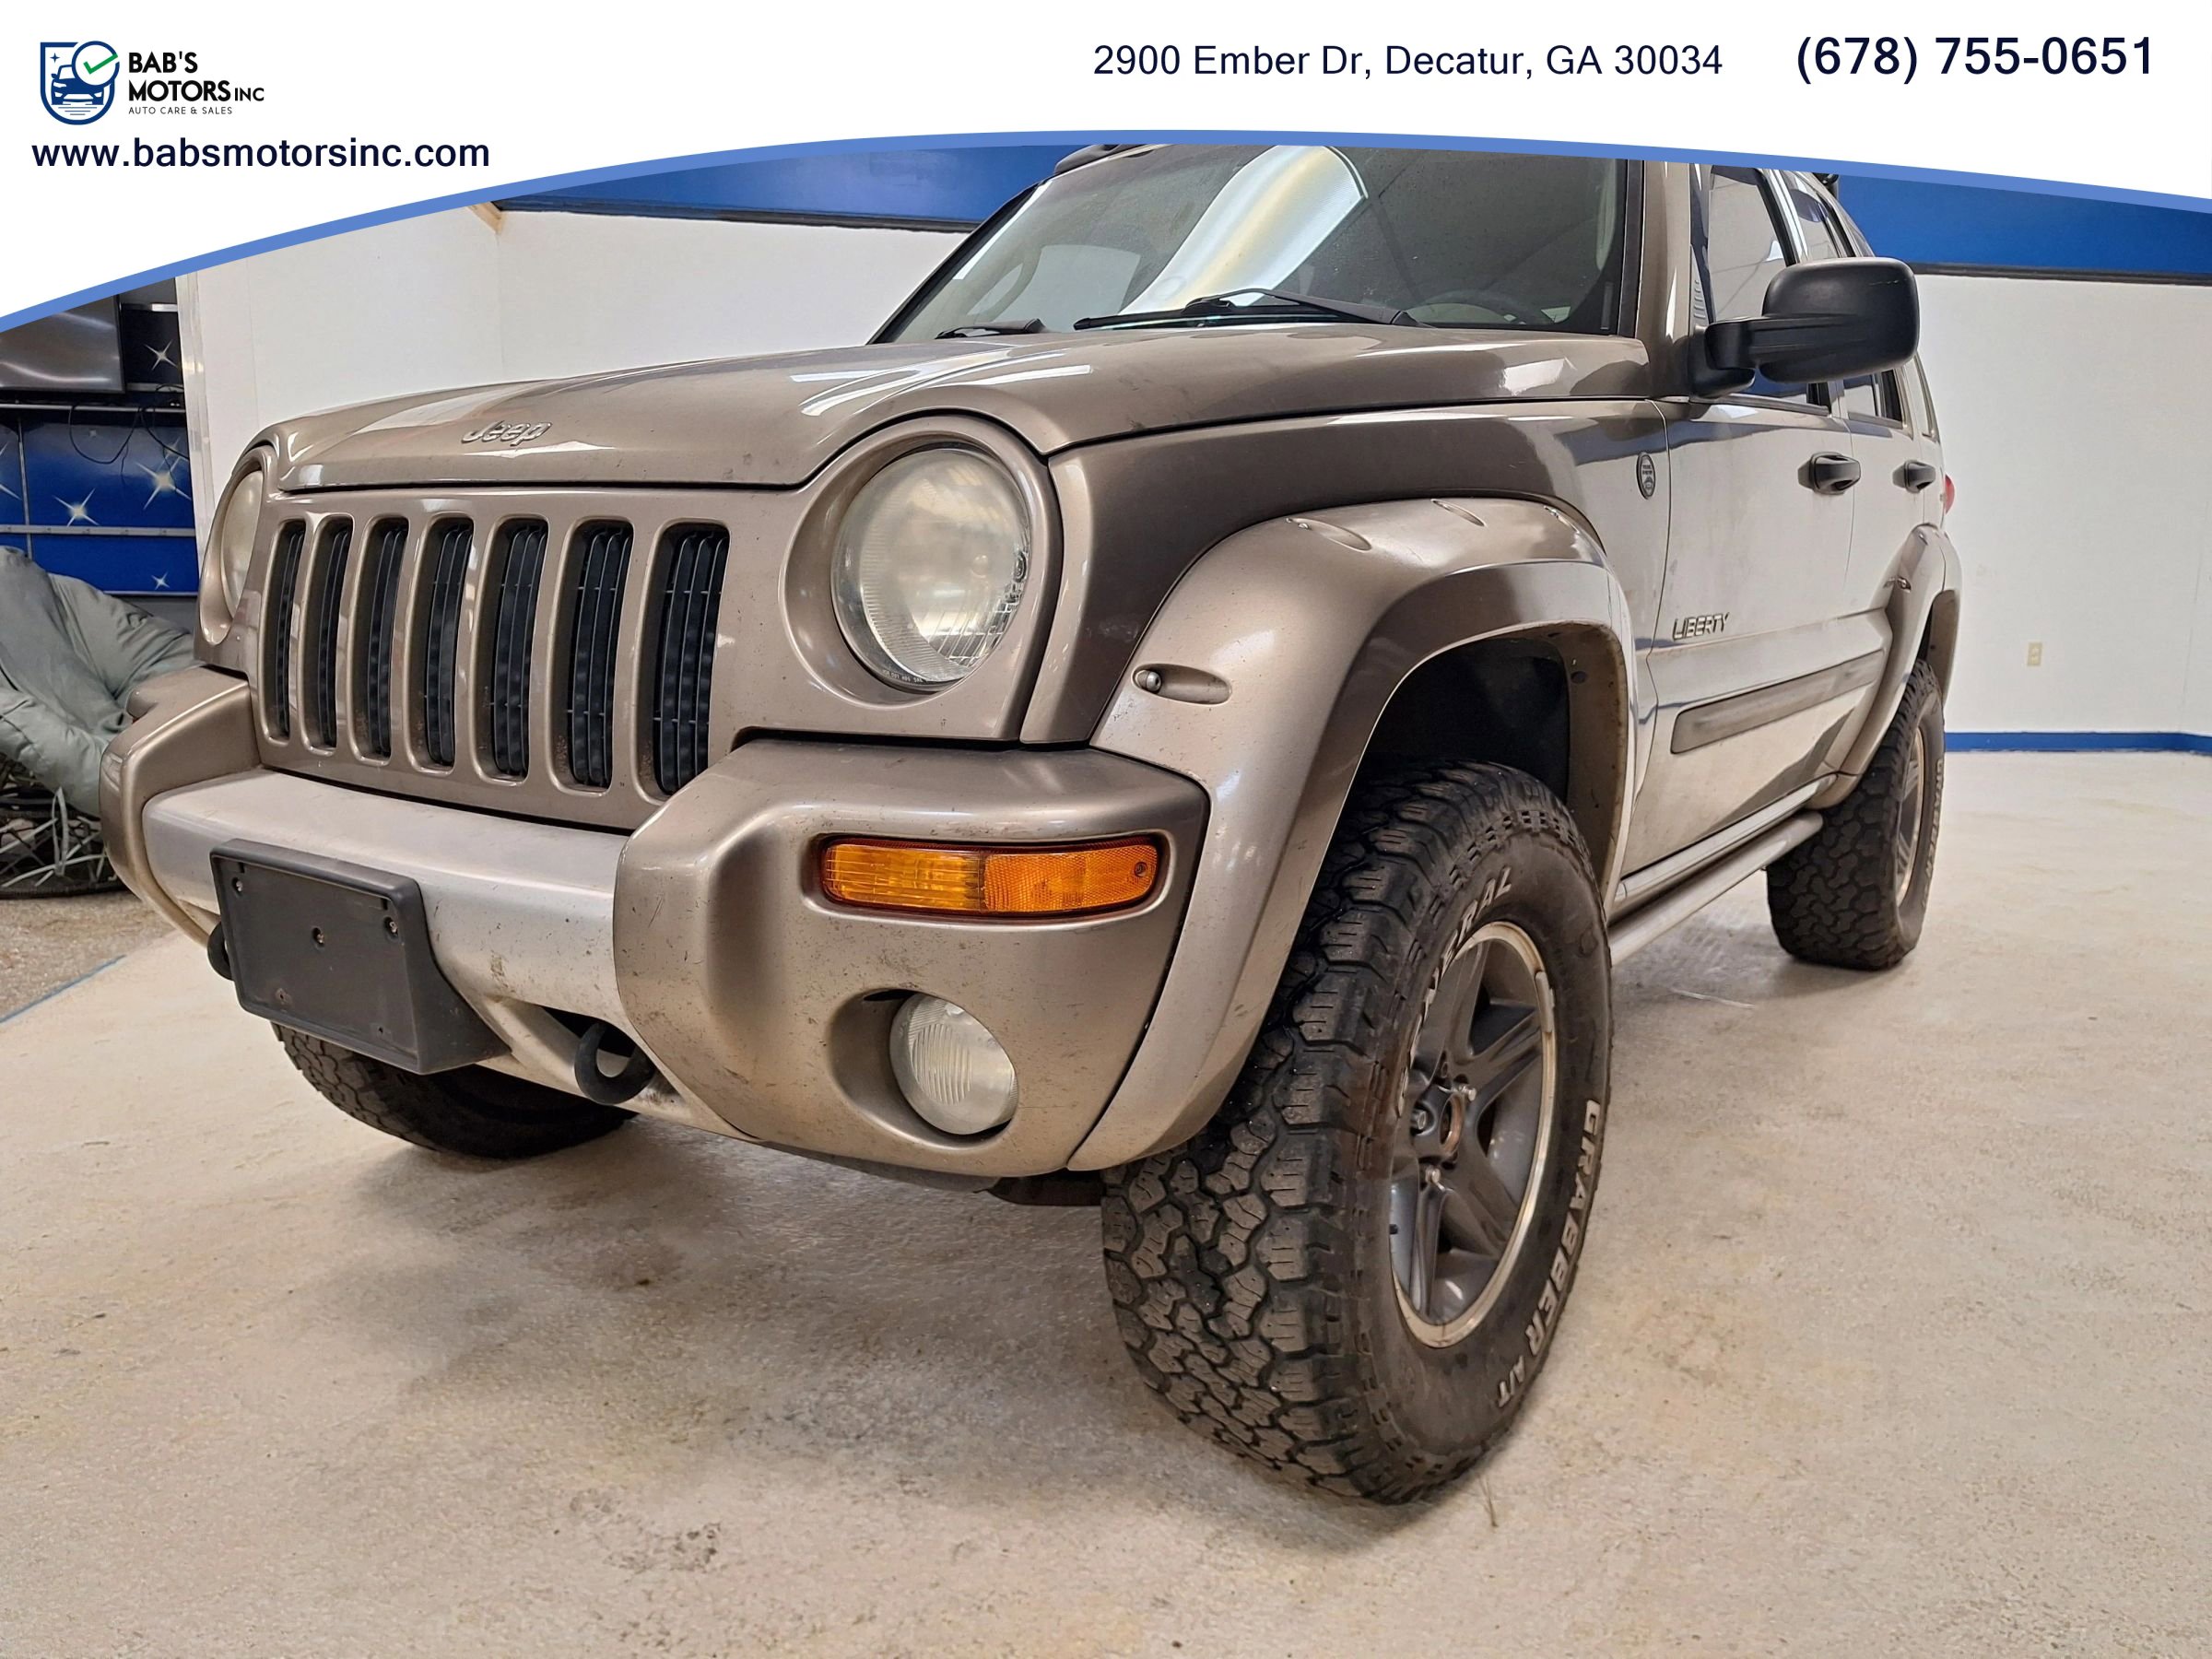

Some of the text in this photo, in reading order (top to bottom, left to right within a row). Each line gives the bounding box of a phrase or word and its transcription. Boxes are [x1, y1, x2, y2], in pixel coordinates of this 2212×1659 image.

[461, 419, 553, 447] Jeep
[1673, 612, 1730, 641] LIBERTY
[1496, 1098, 1602, 1409] GRABBER A/T
